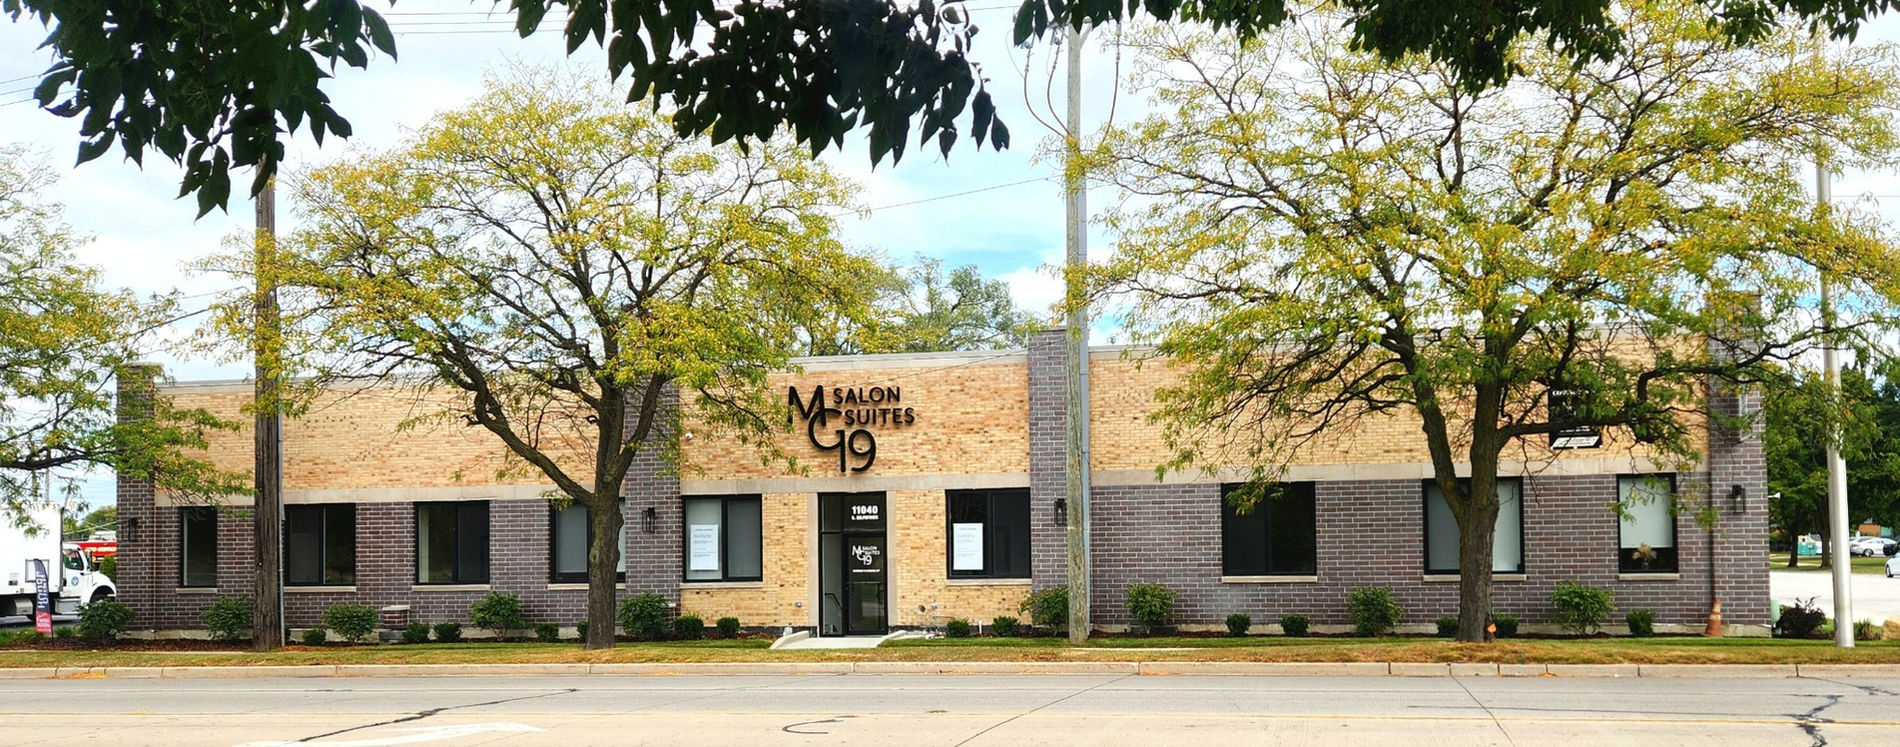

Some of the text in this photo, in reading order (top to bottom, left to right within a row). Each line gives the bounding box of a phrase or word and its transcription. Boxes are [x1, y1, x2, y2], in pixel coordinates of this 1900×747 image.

[833, 386, 901, 404] SALON
[844, 407, 915, 425] SUITES
[851, 505, 879, 515] 11040
